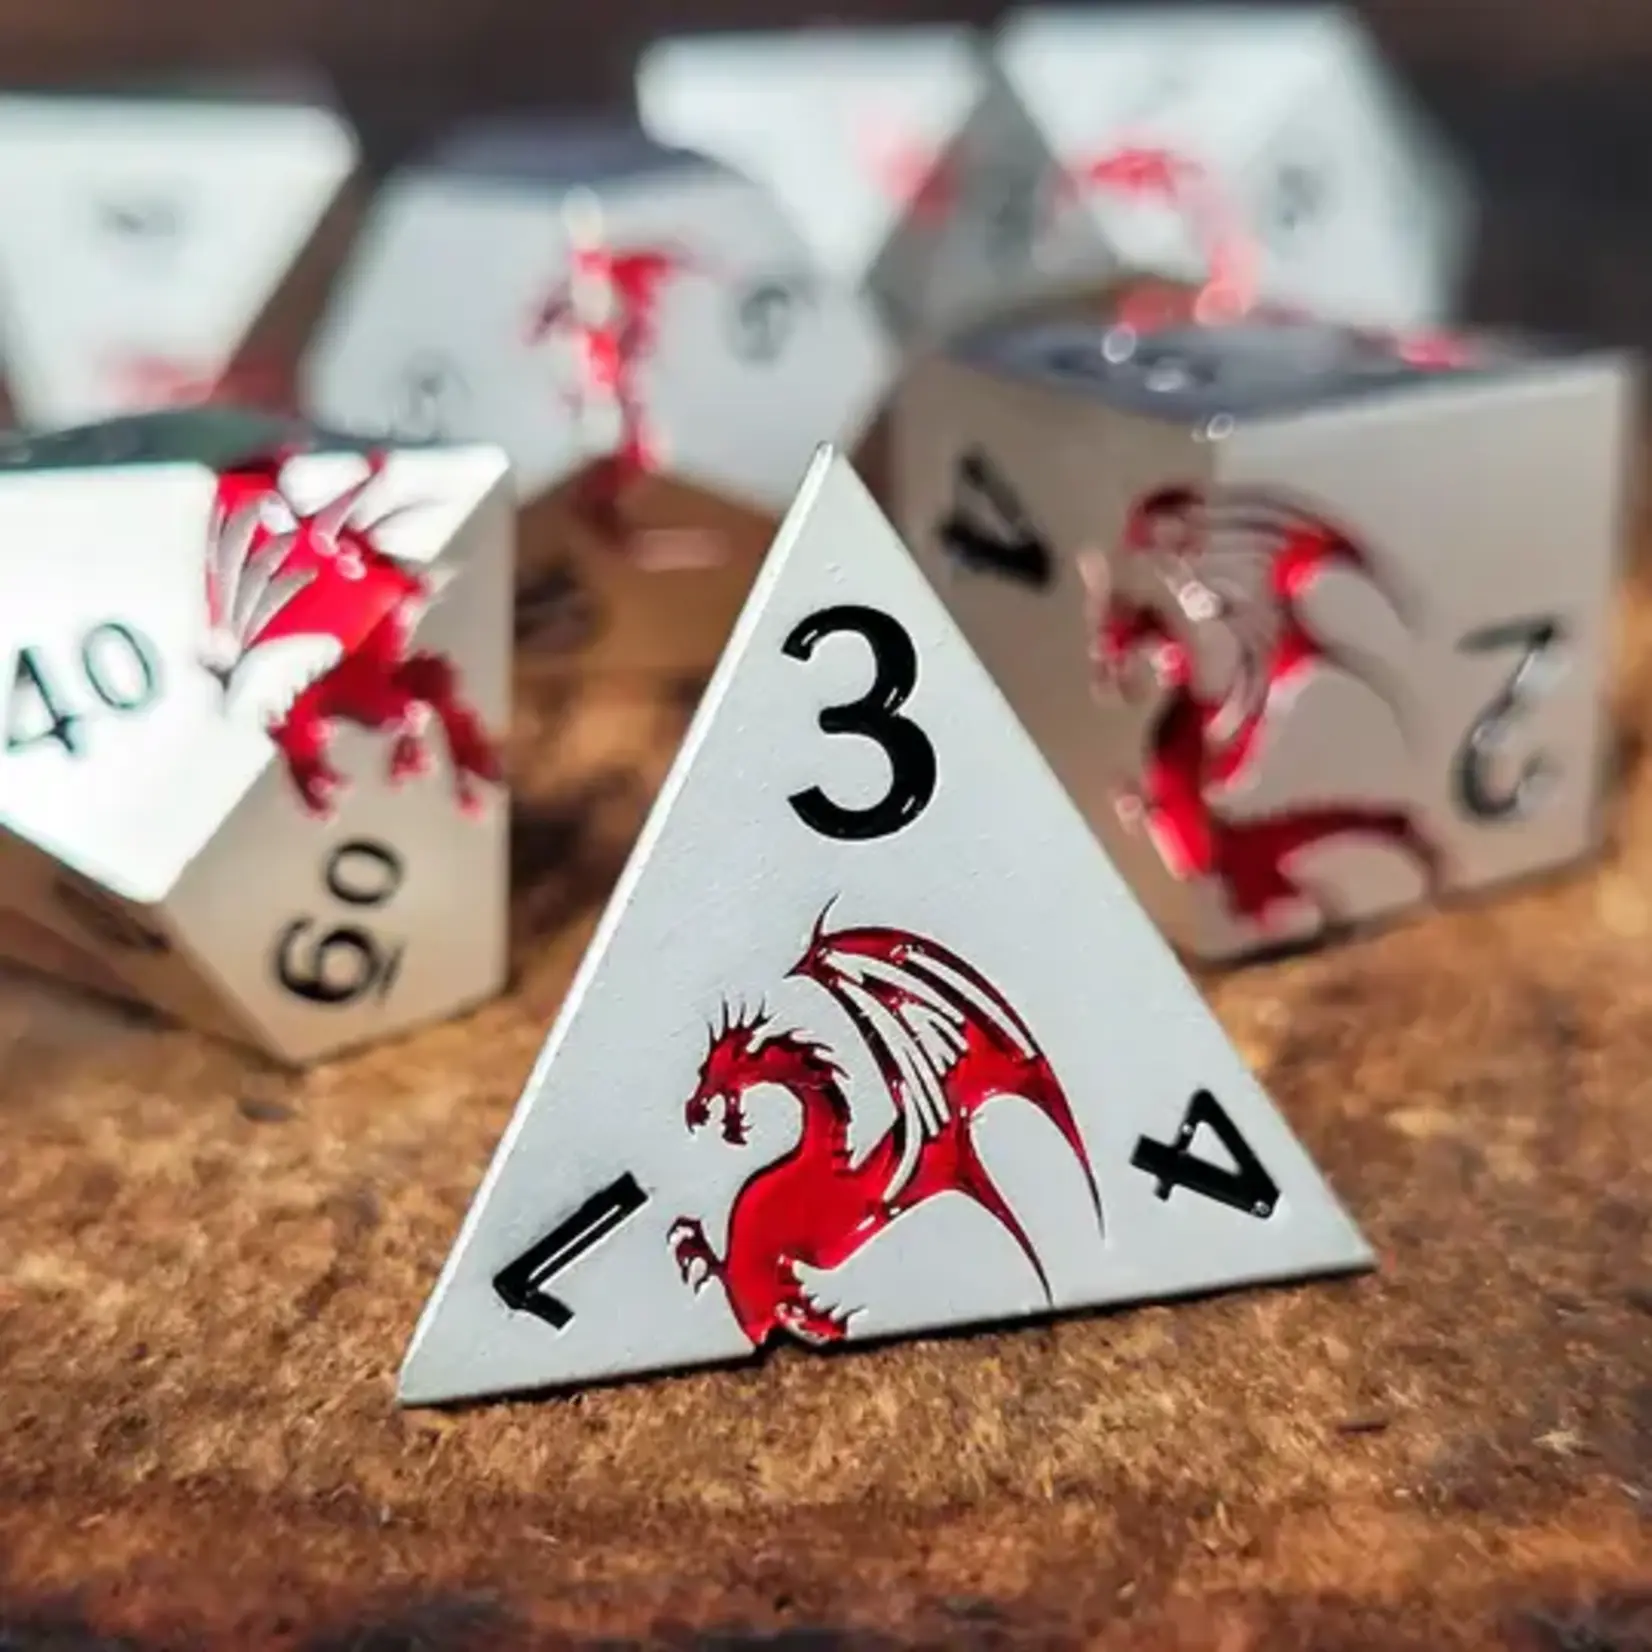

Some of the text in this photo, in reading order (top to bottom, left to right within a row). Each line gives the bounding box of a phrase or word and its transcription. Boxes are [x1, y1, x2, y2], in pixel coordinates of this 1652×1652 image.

[935, 445, 1056, 592] 4
[5, 620, 158, 757] 40
[782, 605, 937, 841] 3
[272, 839, 402, 1010] 60
[1131, 1089, 1280, 1219] 4
[492, 1171, 649, 1330] 1
